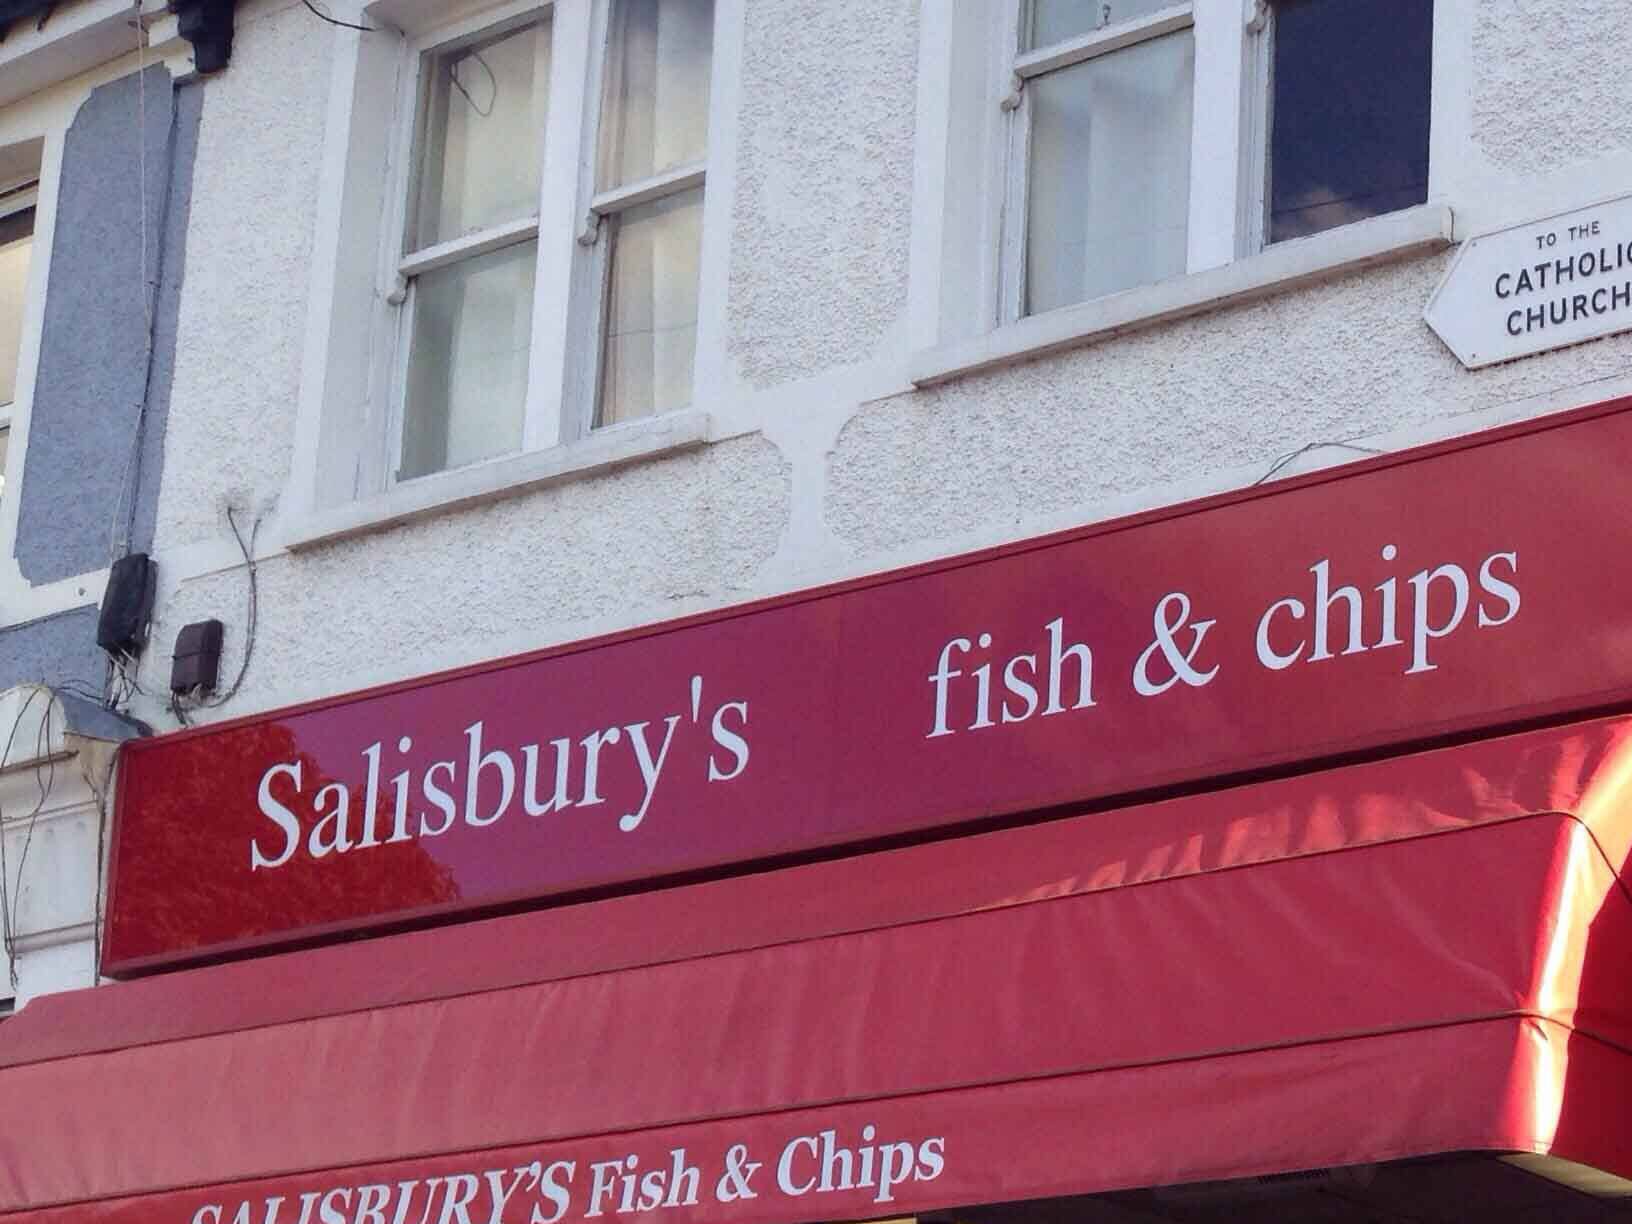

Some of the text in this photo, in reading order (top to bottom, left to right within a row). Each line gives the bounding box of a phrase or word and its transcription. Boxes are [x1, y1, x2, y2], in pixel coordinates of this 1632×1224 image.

[1536, 220, 1601, 250] TO THE
[1506, 281, 1631, 336] CHURCH
[250, 544, 1522, 873] Salisbury's fish & chips
[583, 1152, 699, 1218] Fish
[716, 1143, 763, 1202] &
[777, 1124, 947, 1206] Chips
